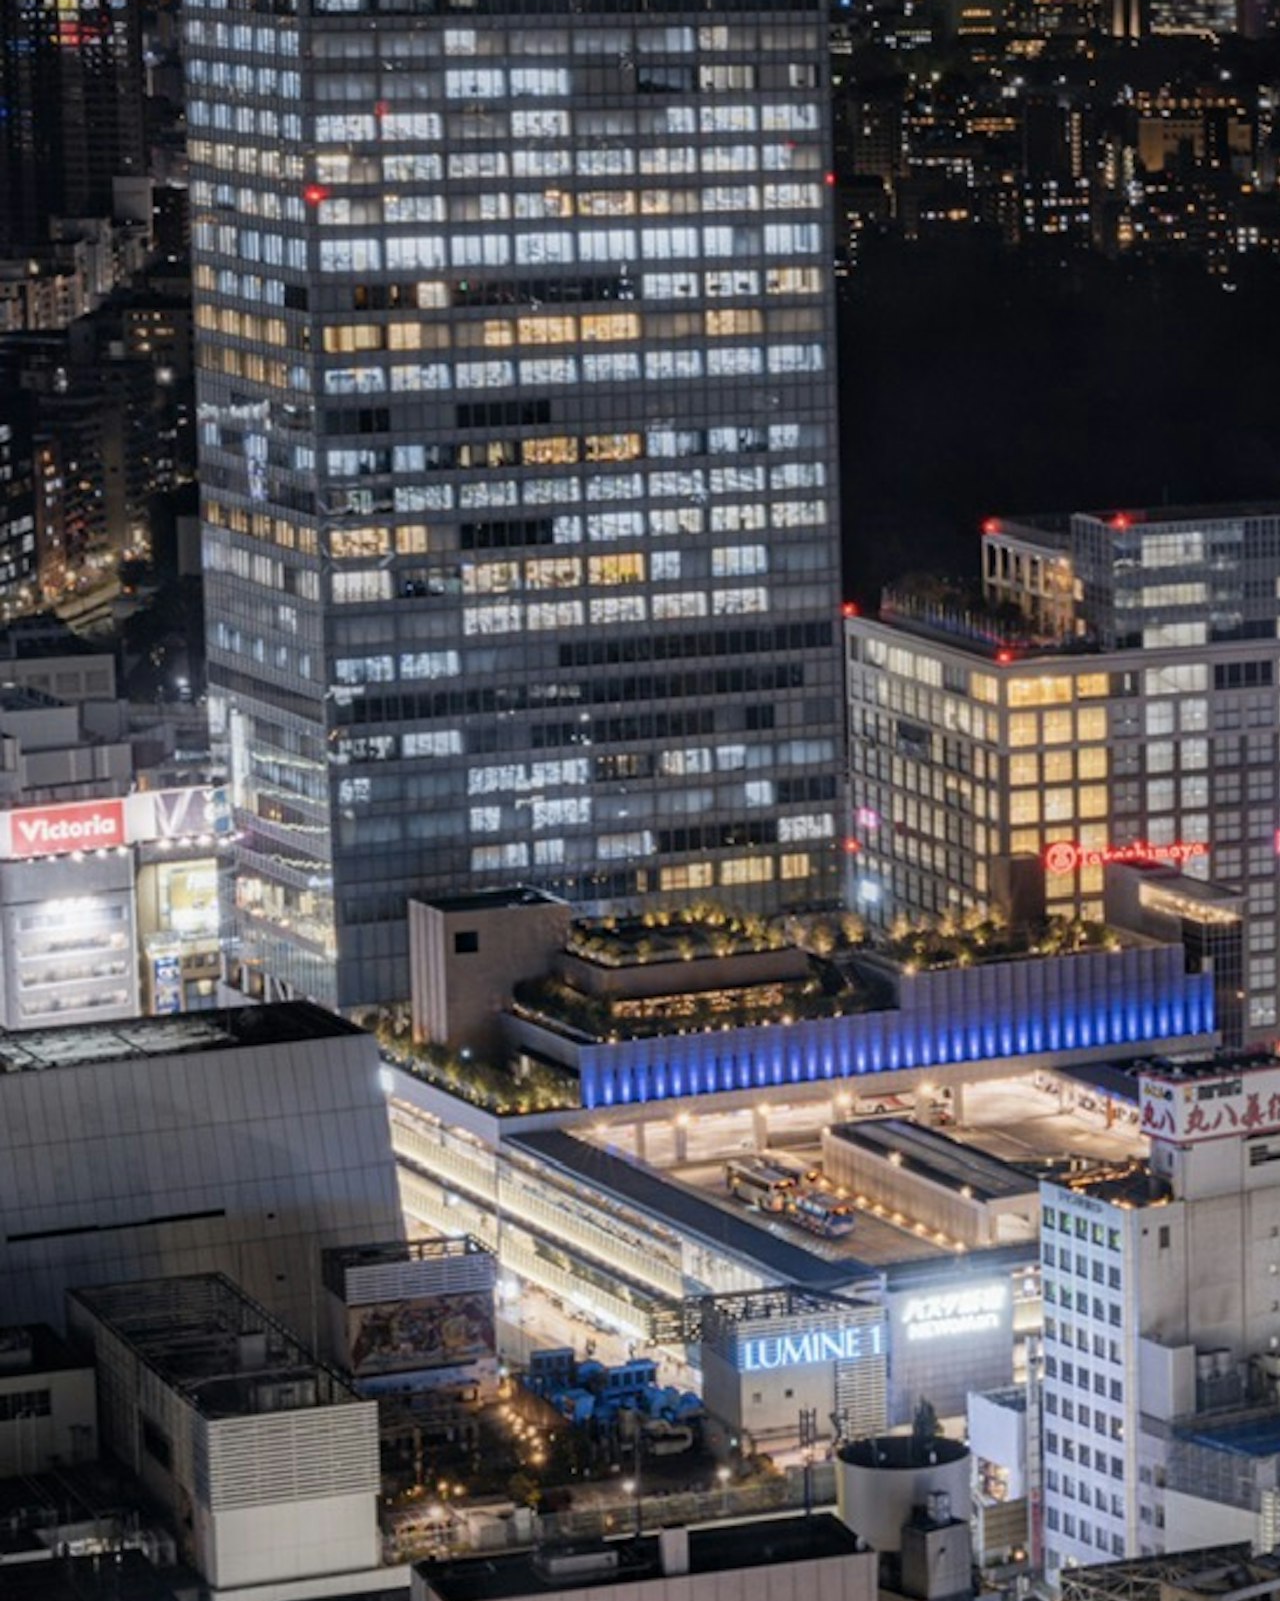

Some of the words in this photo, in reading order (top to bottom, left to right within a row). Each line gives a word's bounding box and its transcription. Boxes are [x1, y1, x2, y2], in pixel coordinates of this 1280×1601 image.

[19, 814, 116, 842] Victoria
[744, 1324, 861, 1370] LUMINE
[870, 1325, 883, 1355] 1
